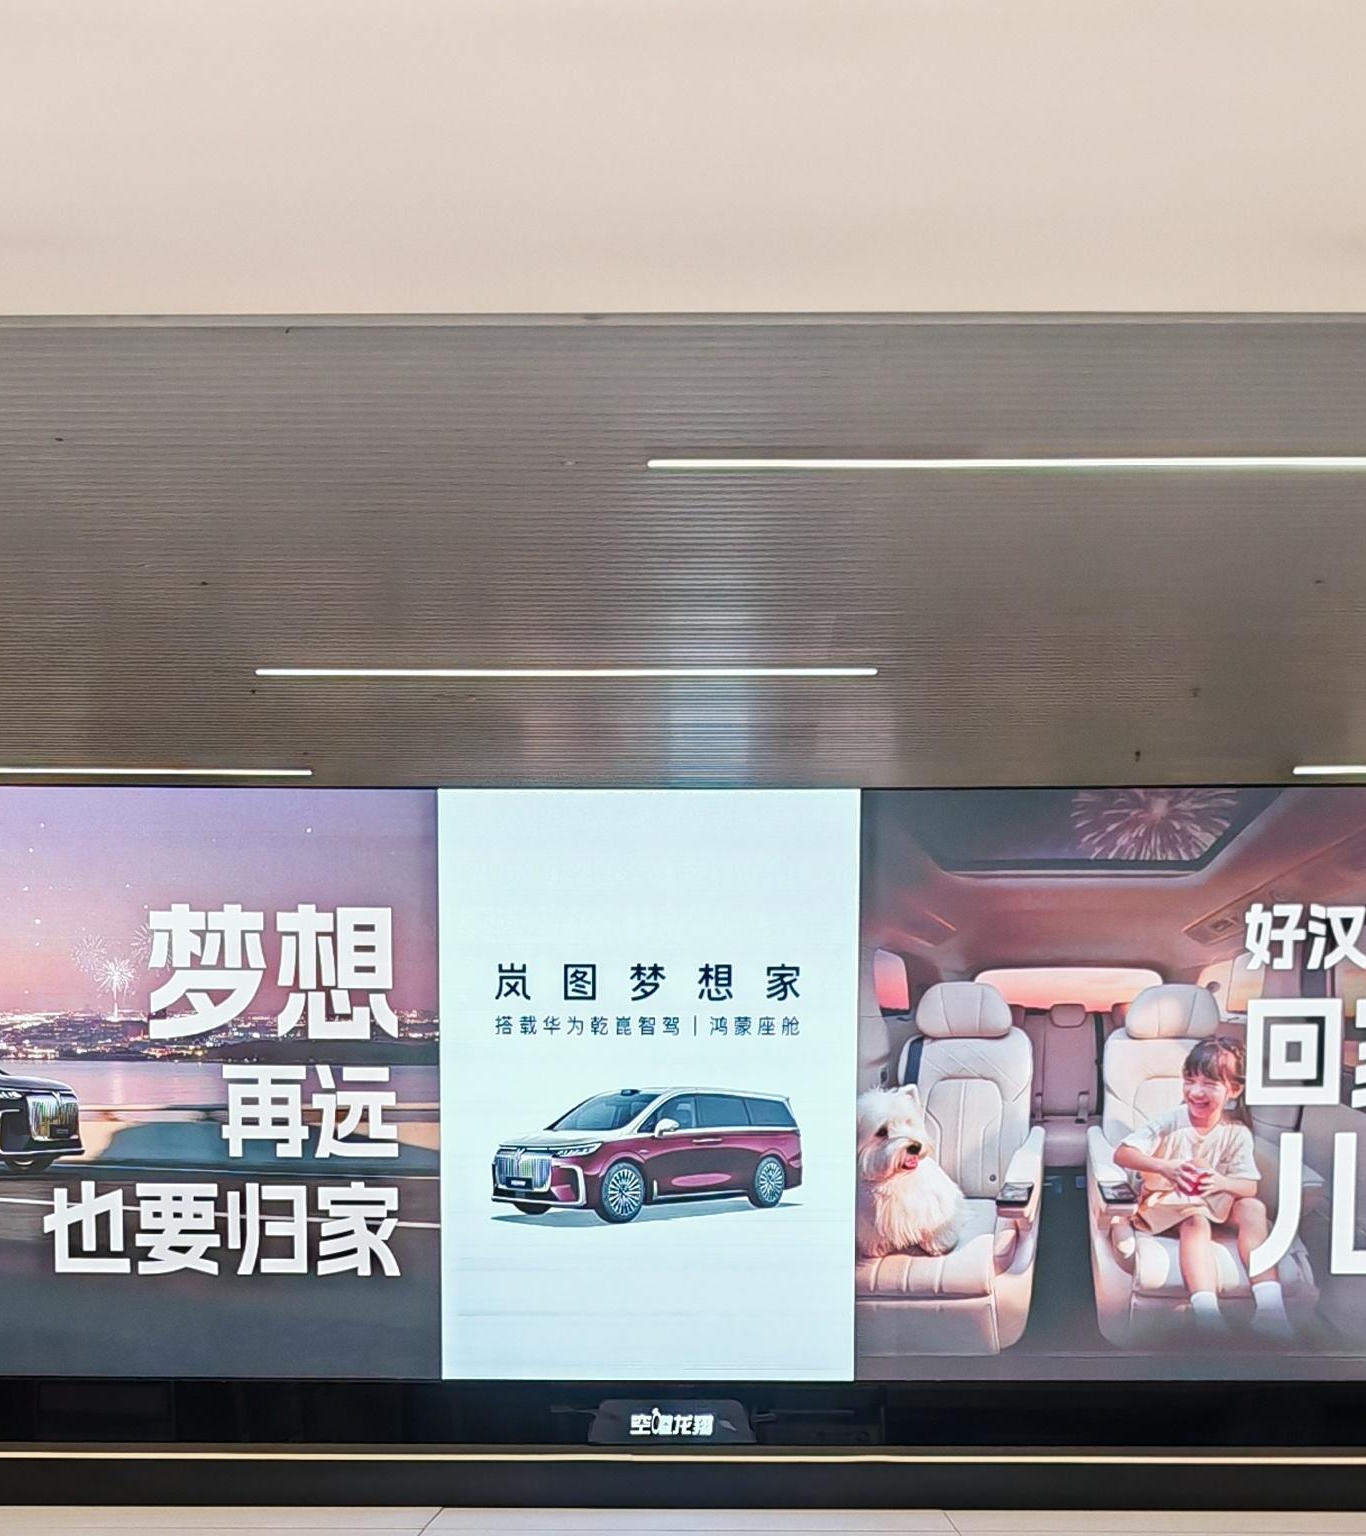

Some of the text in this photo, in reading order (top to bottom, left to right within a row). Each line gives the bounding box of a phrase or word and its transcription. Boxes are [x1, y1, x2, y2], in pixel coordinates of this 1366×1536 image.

[147, 902, 400, 1041] 梦想
[494, 962, 801, 1002] 岚图梦想家
[709, 1015, 801, 1037] 鸿蒙座舱
[221, 1063, 400, 1160] 再远
[42, 1179, 402, 1278] 也要归家
